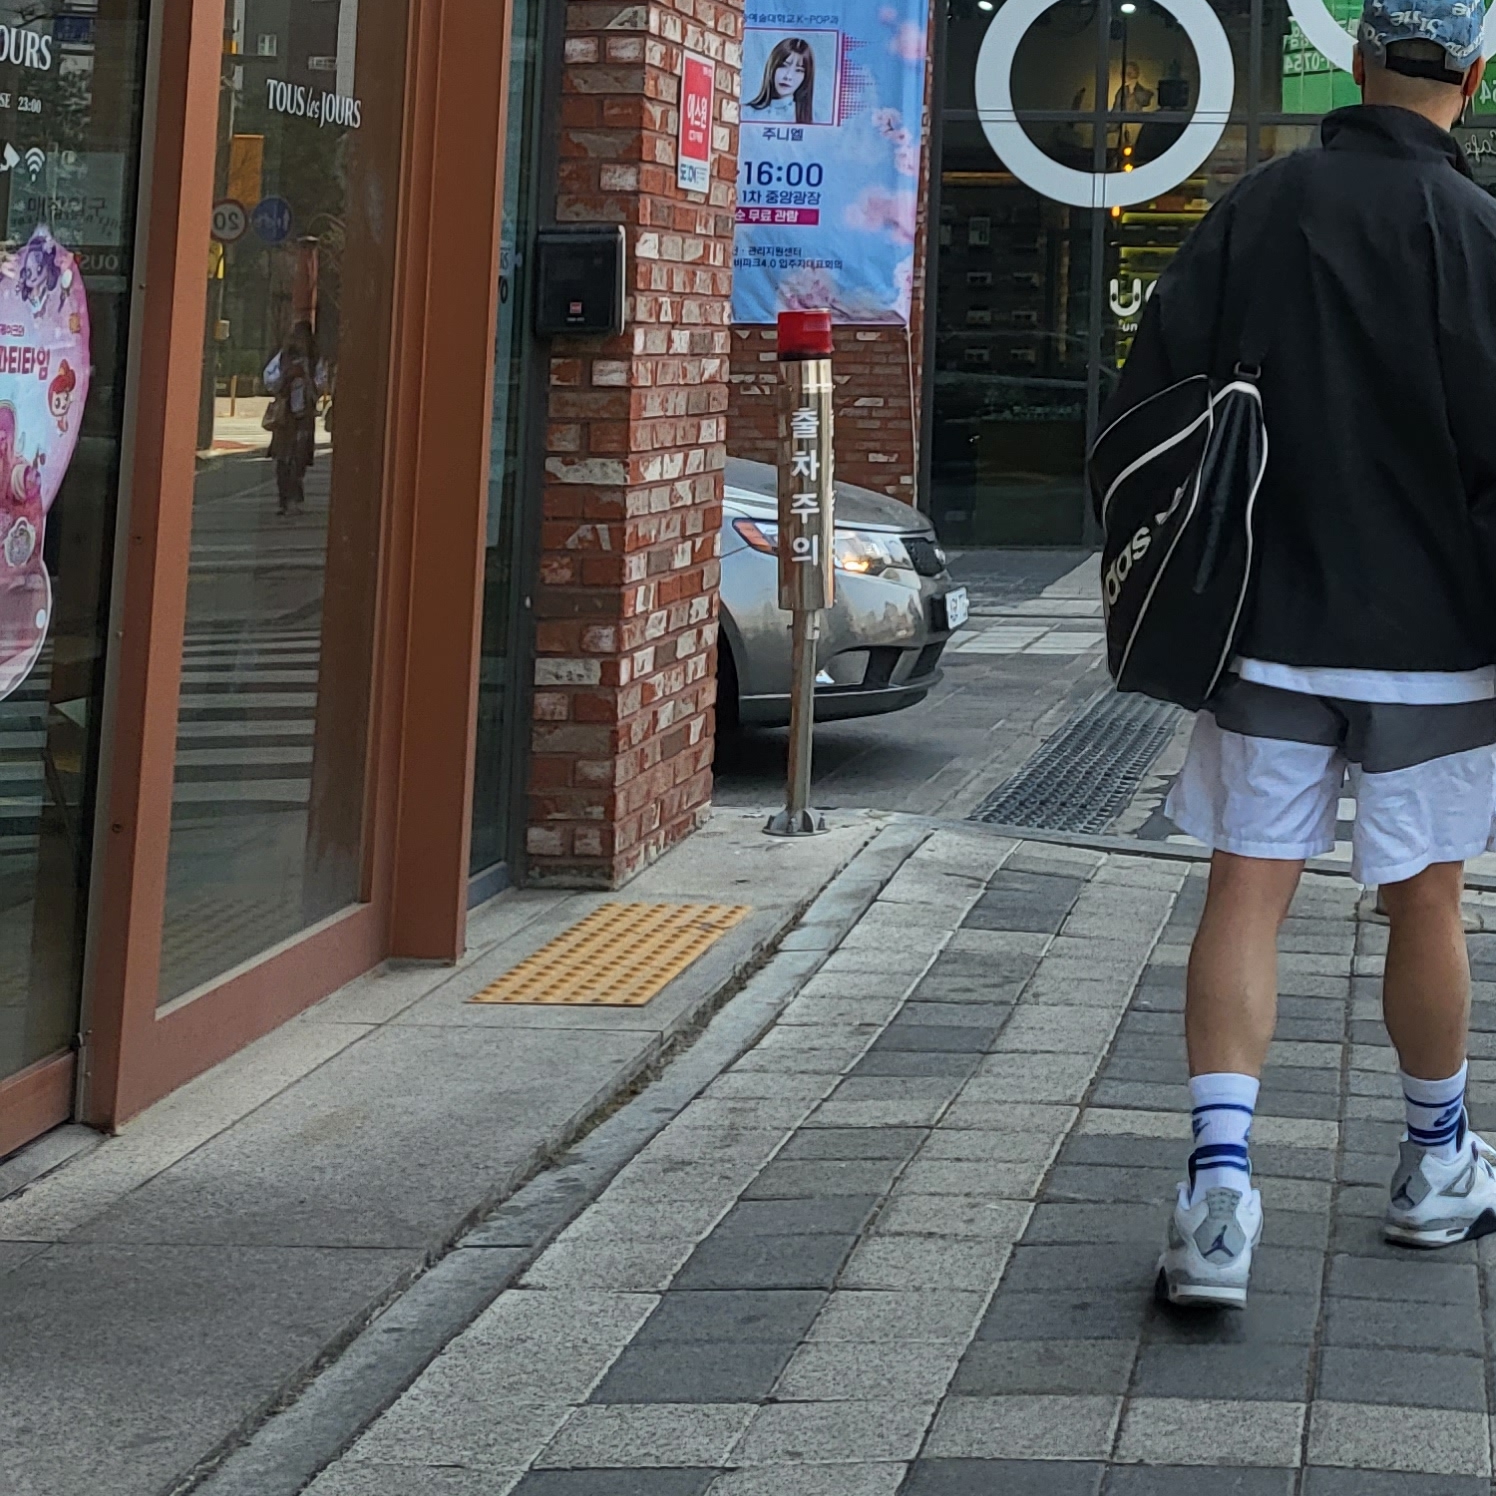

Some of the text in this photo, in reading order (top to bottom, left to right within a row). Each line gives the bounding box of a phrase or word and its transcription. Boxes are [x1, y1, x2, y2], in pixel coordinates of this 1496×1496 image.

[18, 96, 42, 113] 23:00
[266, 79, 362, 128] TOUS les JOURS
[762, 126, 804, 142] 주니엘
[744, 161, 823, 187] 16:00
[765, 190, 821, 206] 중앙광장
[748, 209, 772, 222] 무료
[775, 210, 799, 223] 관람
[748, 246, 802, 257] 관리지원센터
